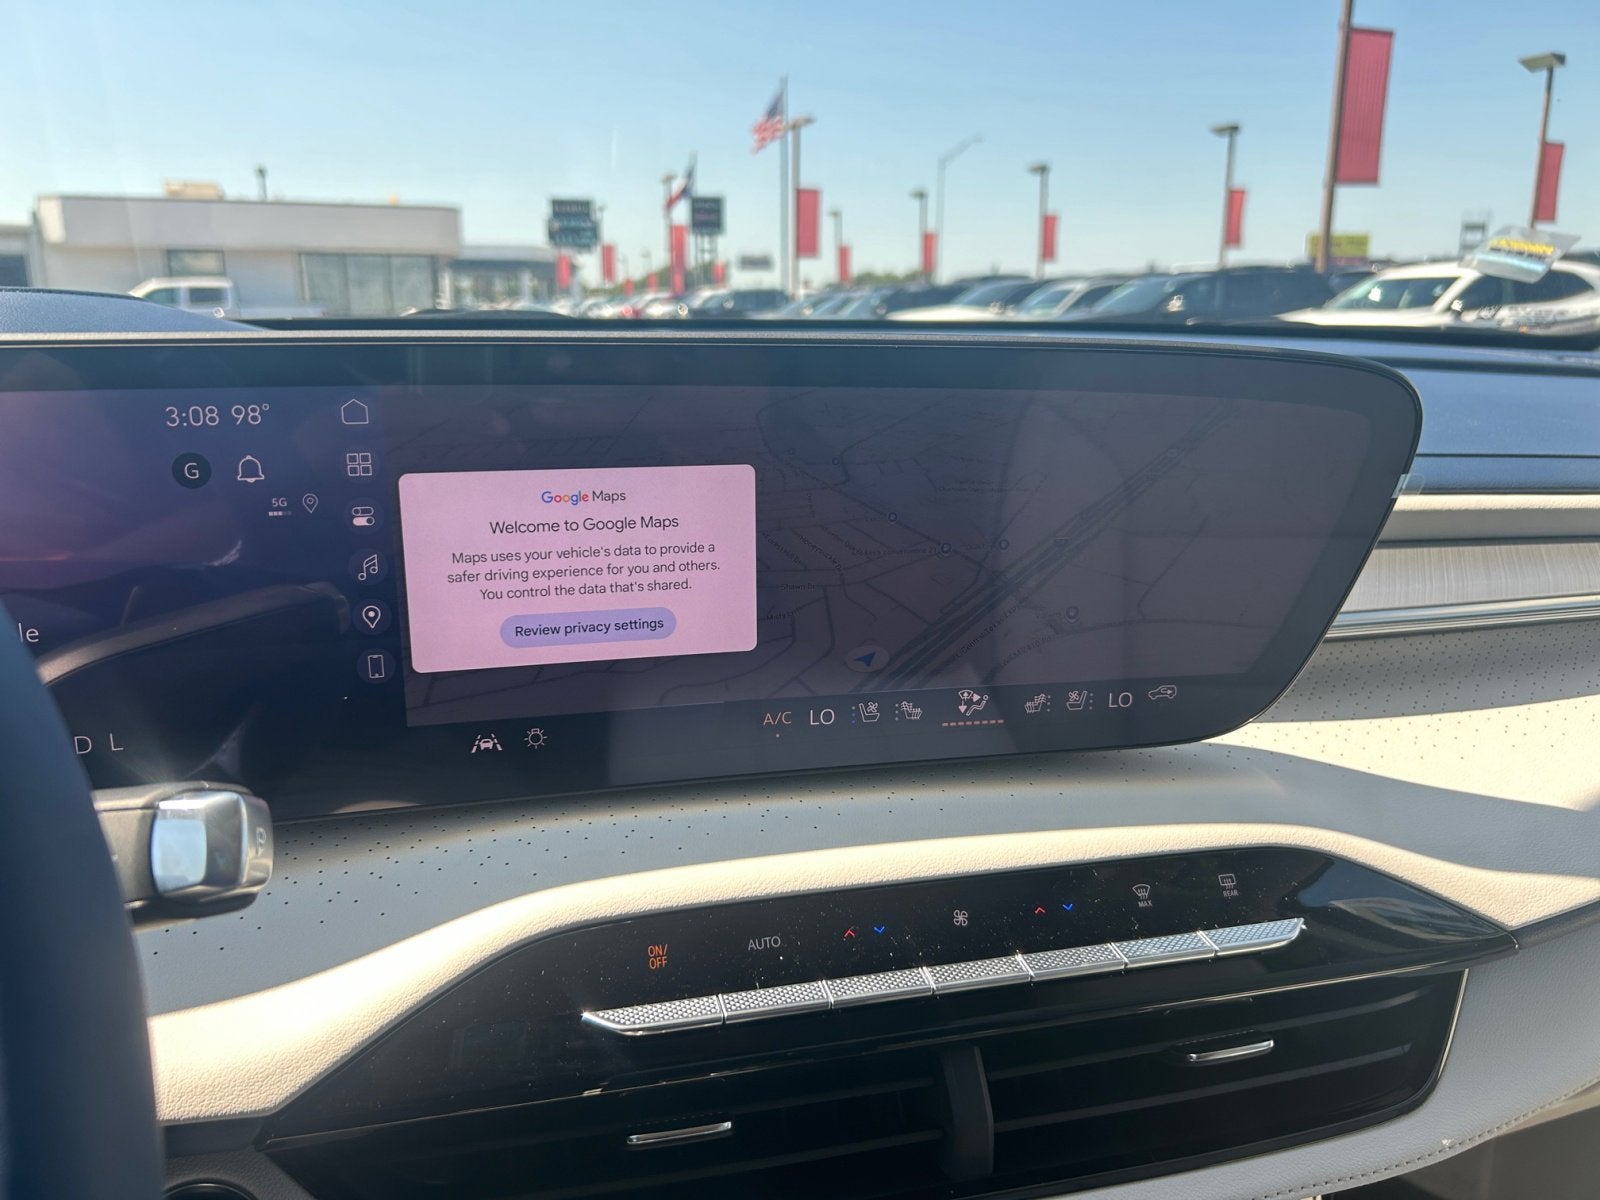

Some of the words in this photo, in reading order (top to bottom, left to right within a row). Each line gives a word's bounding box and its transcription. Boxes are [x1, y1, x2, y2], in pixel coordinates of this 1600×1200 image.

[165, 405, 219, 426] 3:08
[184, 462, 199, 479] G
[271, 497, 287, 507] 5G
[541, 491, 589, 505] Google
[593, 491, 626, 503] Maps
[490, 521, 559, 534] Welcome
[564, 519, 579, 531] to
[583, 517, 636, 533] Google
[640, 516, 678, 530] Maps
[452, 553, 488, 567] Maps
[491, 552, 521, 562] uses
[524, 550, 552, 563] your
[556, 547, 611, 559] vehicle's
[614, 546, 641, 557] data
[645, 545, 656, 555] to
[660, 542, 704, 557] provide
[708, 544, 714, 552] a
[448, 570, 480, 583] safer
[484, 568, 529, 582] driving
[532, 566, 603, 581] experience
[607, 563, 623, 576] for
[627, 564, 649, 578] you
[653, 561, 675, 572] and
[679, 560, 720, 571] others.
[480, 589, 503, 600] You
[507, 586, 550, 599] control
[555, 584, 575, 595] the
[579, 583, 606, 595] data
[610, 581, 644, 594] that's
[647, 579, 692, 592] shared.
[516, 623, 560, 637] Review
[565, 621, 610, 636] privacy
[614, 618, 664, 634] settings
[1108, 691, 1133, 708] LO
[763, 710, 792, 726] A/C
[809, 708, 835, 725] LO
[74, 735, 92, 755] D
[109, 732, 124, 751] L
[1223, 889, 1238, 897] REAR
[647, 943, 669, 957] ON/
[748, 935, 781, 951] AUTO
[649, 956, 667, 970] OFF
